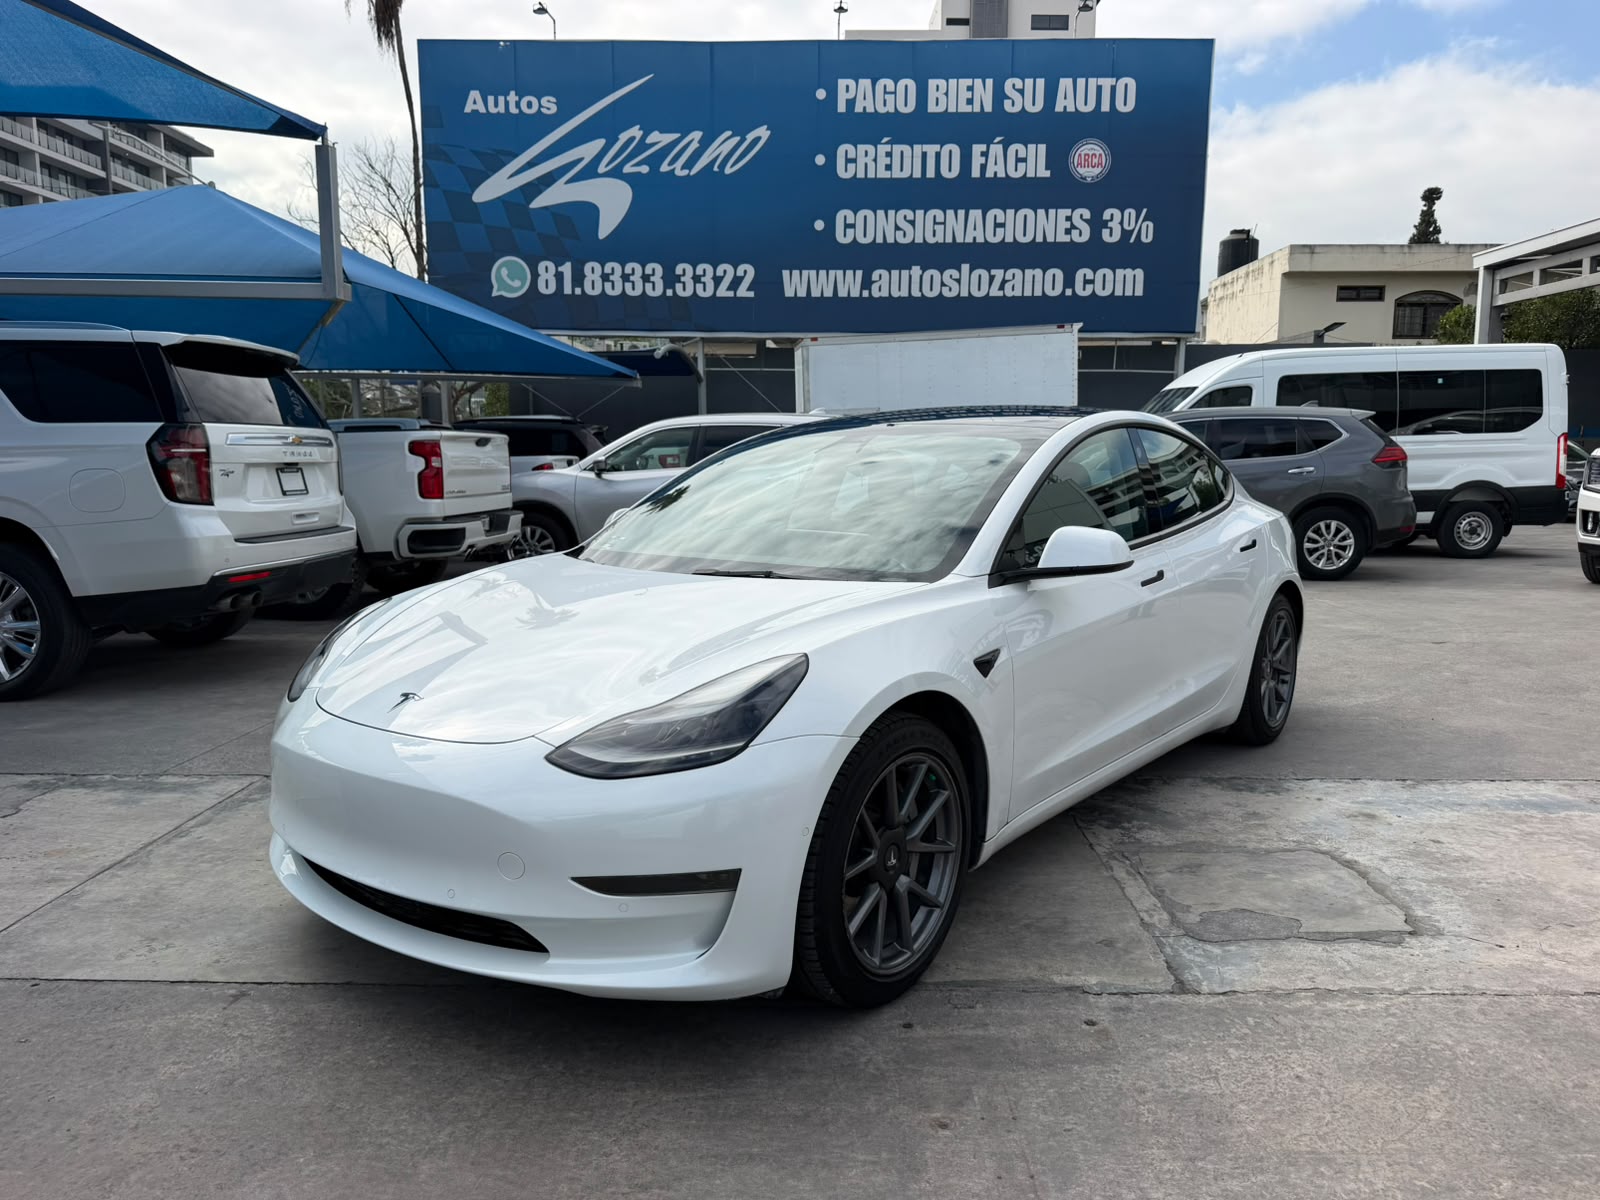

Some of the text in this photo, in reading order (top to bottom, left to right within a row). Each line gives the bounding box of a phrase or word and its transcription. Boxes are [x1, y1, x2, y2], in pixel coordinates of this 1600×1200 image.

[463, 90, 558, 115] Autos
[837, 76, 1137, 114] PAGO BIEN SU AUTO
[836, 136, 1051, 179] CRÉDITO FÁCIL
[1076, 152, 1104, 169] ARCA
[835, 207, 1154, 244] CONSIGNACIONES 3%
[537, 260, 755, 298] 81.8333.3322
[782, 263, 1144, 298] www.autoslozano.com
